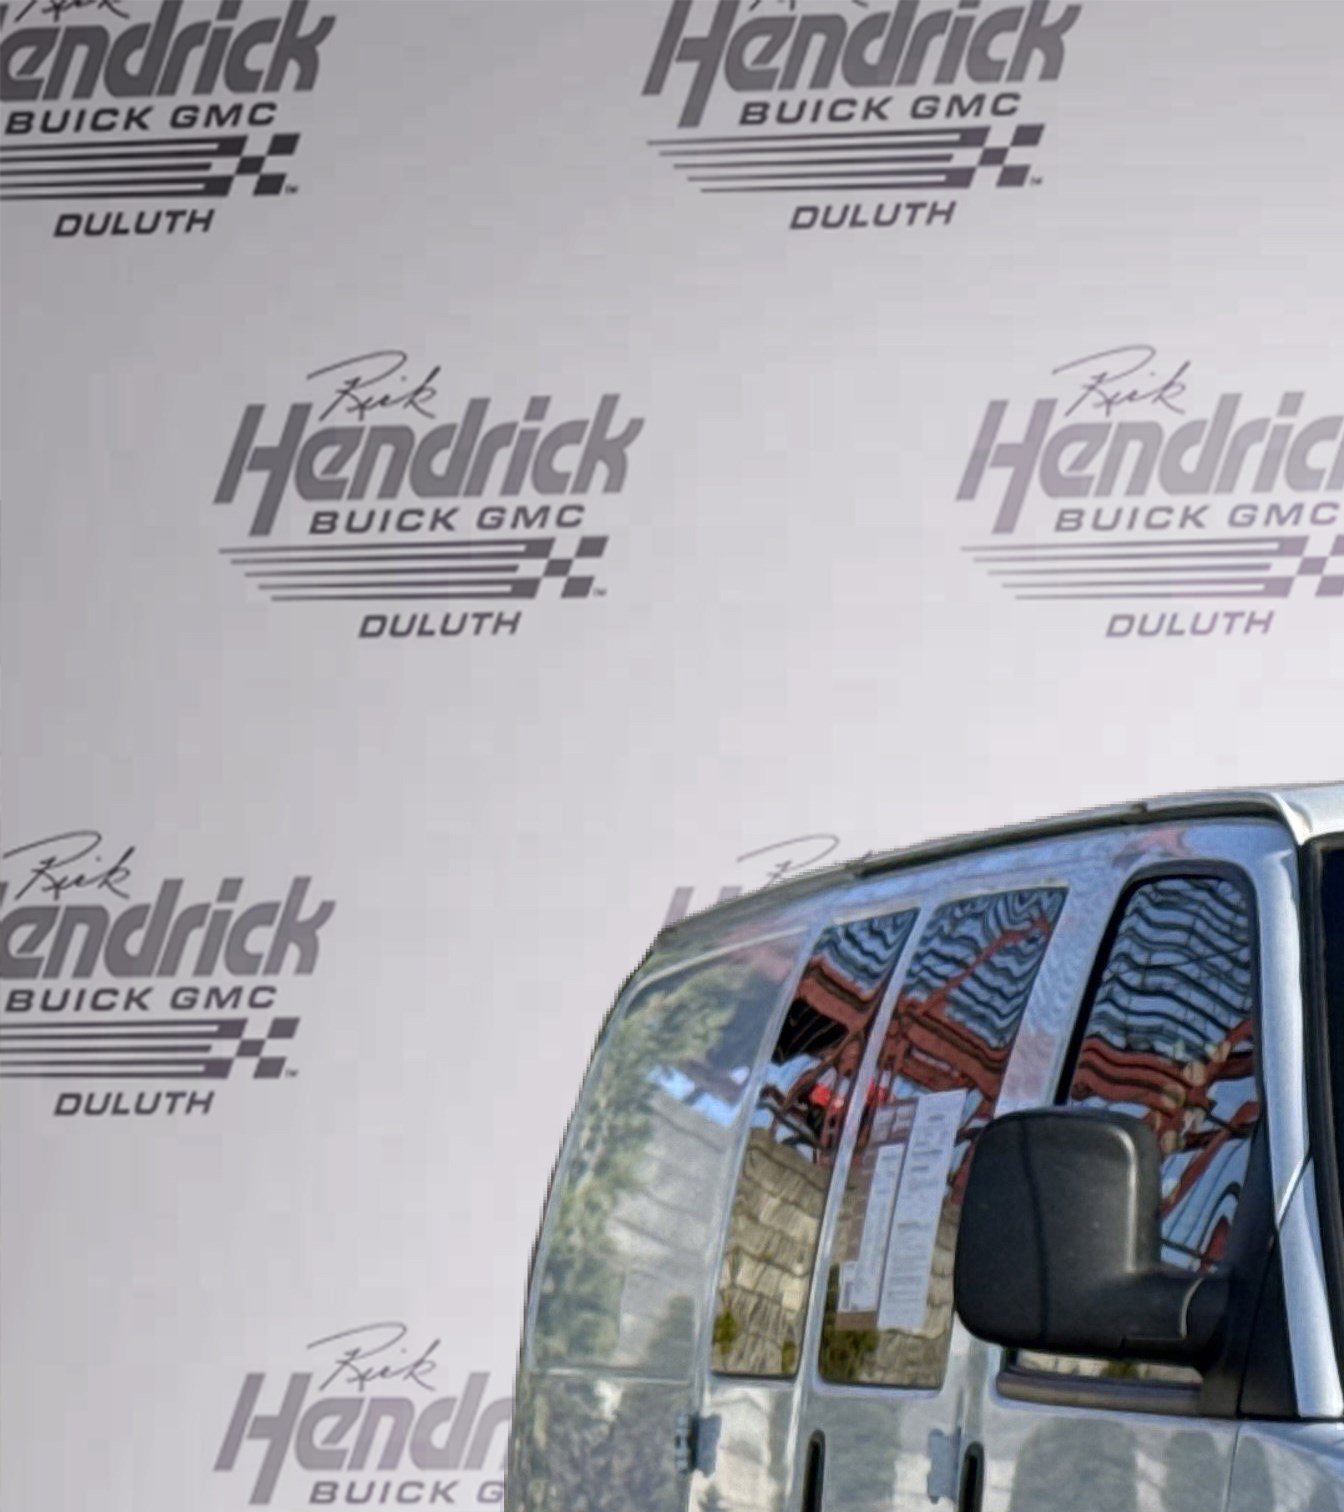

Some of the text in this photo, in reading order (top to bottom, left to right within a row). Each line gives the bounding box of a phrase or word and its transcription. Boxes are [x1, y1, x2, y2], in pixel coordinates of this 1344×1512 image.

[0, 0, 336, 101] endrick
[641, 0, 1082, 128] Hendrick
[4, 103, 277, 135] BUICK GMC
[738, 93, 1021, 126] BUICK GMC
[53, 209, 215, 237] DULUTH
[789, 201, 956, 230] DULUTH
[212, 394, 645, 537] Hendrick
[309, 505, 585, 534] BUICK GMC
[1054, 502, 1340, 532] BUICK GMC
[358, 611, 522, 638] DULUTH
[1105, 610, 1275, 638] DULUTH
[0, 876, 336, 980] endrick
[5, 986, 277, 1012] BUICK GMC
[54, 1091, 214, 1116] DULUTH
[213, 1372, 515, 1505] Hendr
[308, 1481, 459, 1505] BUICK
